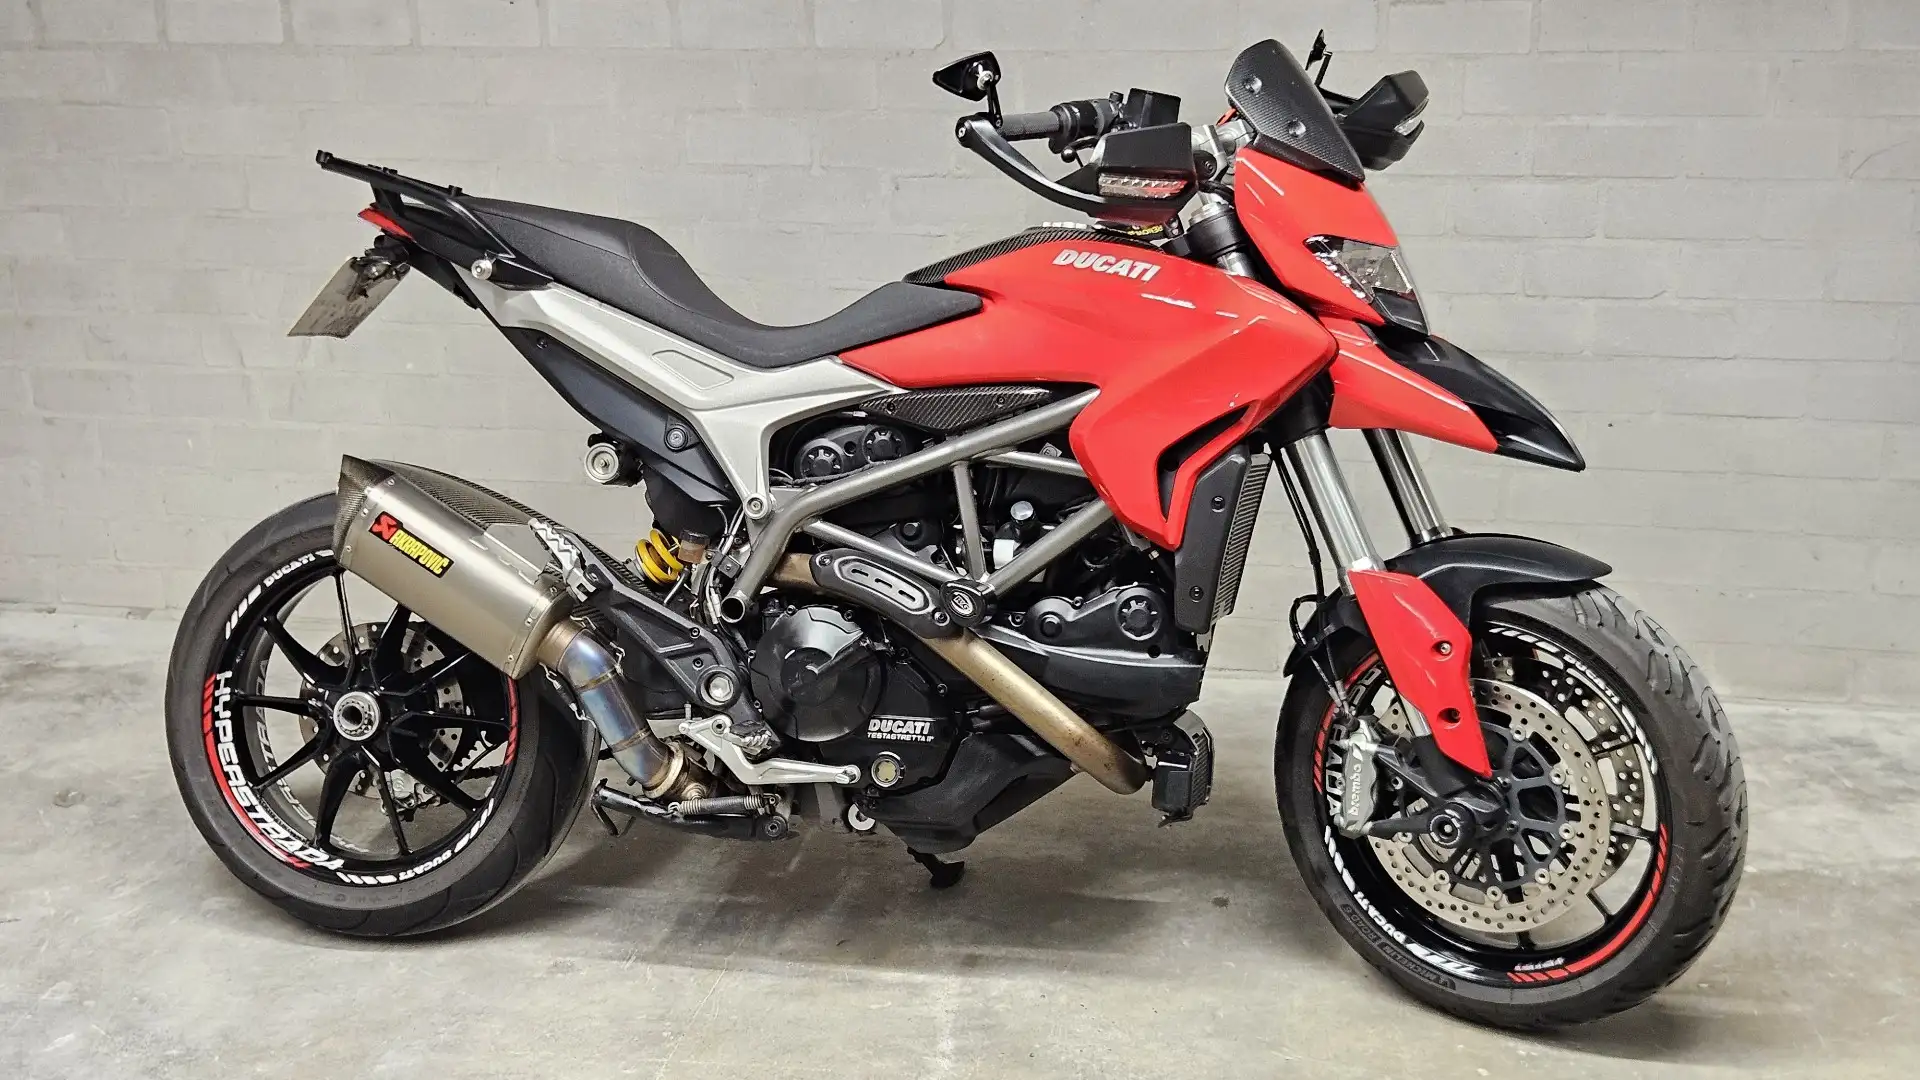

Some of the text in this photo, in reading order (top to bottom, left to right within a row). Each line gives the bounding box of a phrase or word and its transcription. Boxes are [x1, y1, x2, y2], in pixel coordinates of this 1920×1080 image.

[1052, 249, 1161, 281] DUCATI
[263, 553, 316, 587] DUCATI
[1563, 654, 1620, 704] DUCATI
[867, 732, 925, 742] TESTASTRETTA
[868, 719, 931, 735] DUCATI
[213, 670, 345, 870] HYPERSTRADA
[1350, 763, 1363, 816] brembo
[399, 849, 452, 880] DUCATI
[1354, 891, 1407, 944] DUCATI
[1382, 944, 1438, 984] MICHELIN
